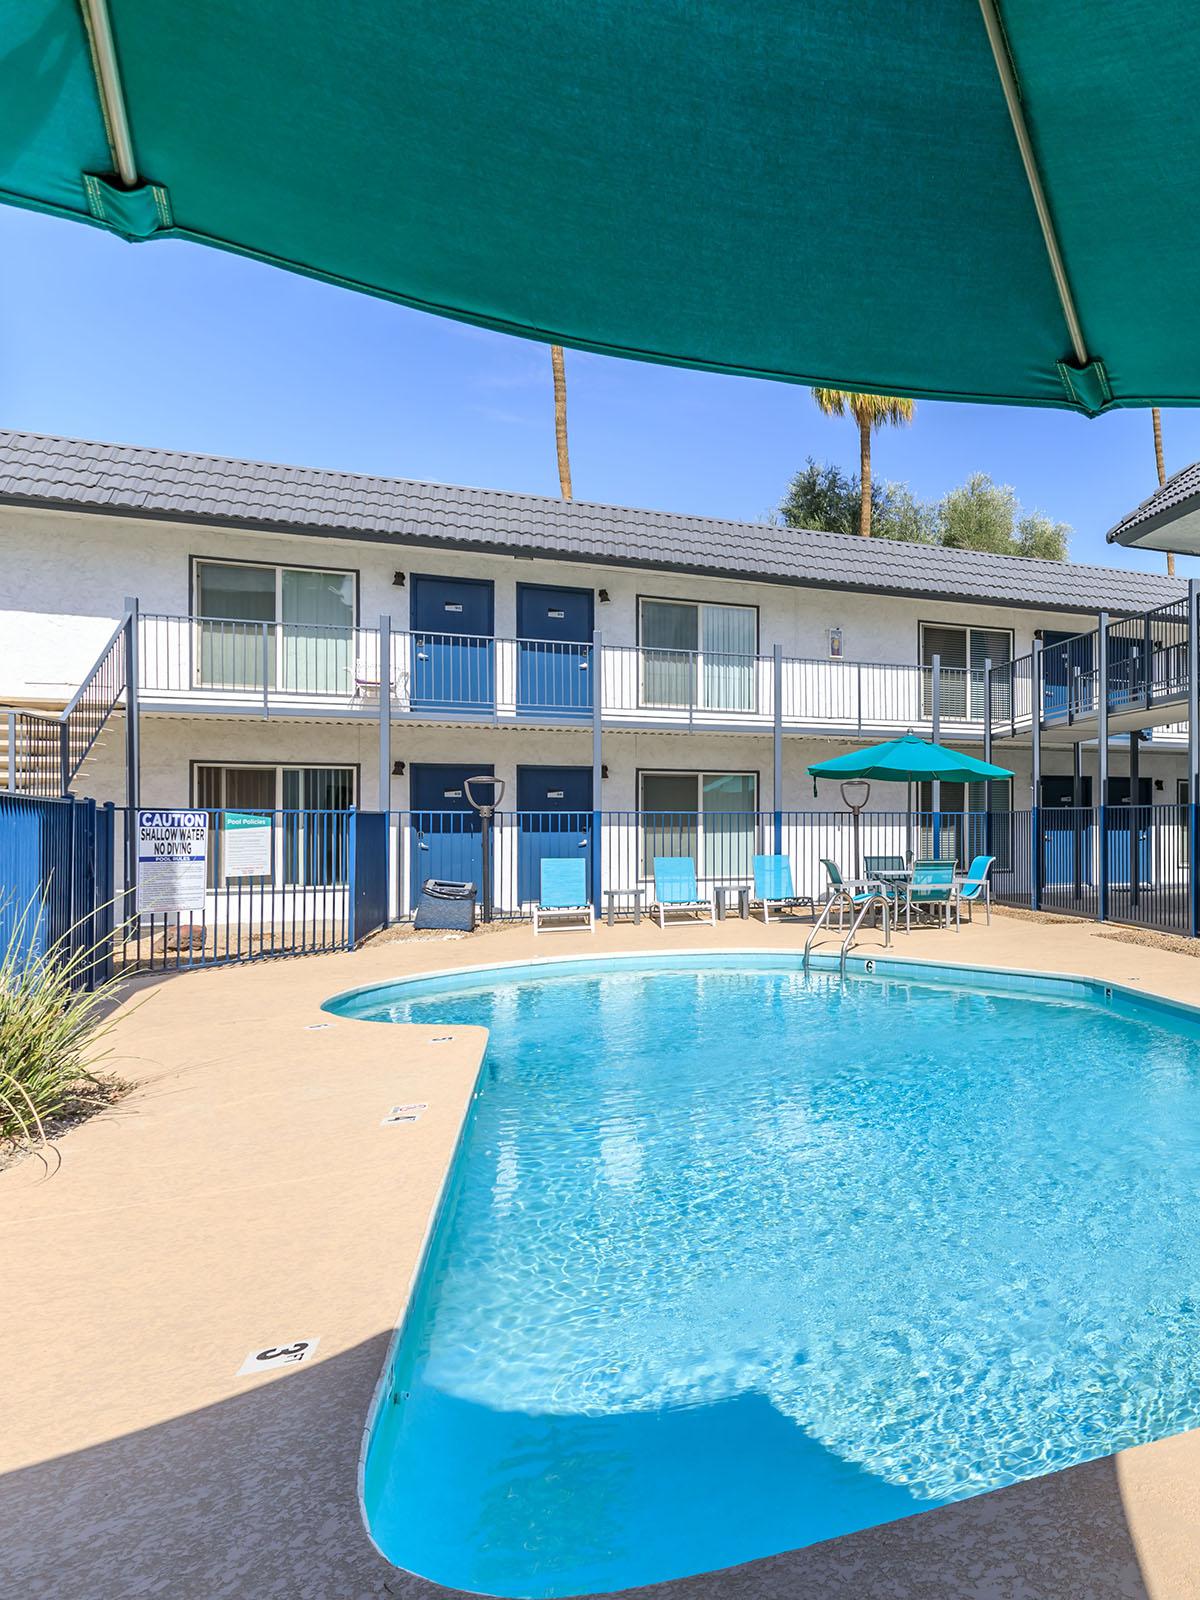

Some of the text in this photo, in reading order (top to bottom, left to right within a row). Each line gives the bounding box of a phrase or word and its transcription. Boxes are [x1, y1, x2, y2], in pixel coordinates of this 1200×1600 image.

[142, 813, 205, 827] CAUTION
[140, 828, 205, 841] SHALLOW WATER
[153, 842, 192, 855] NO DIVING
[256, 1342, 309, 1361] 3
